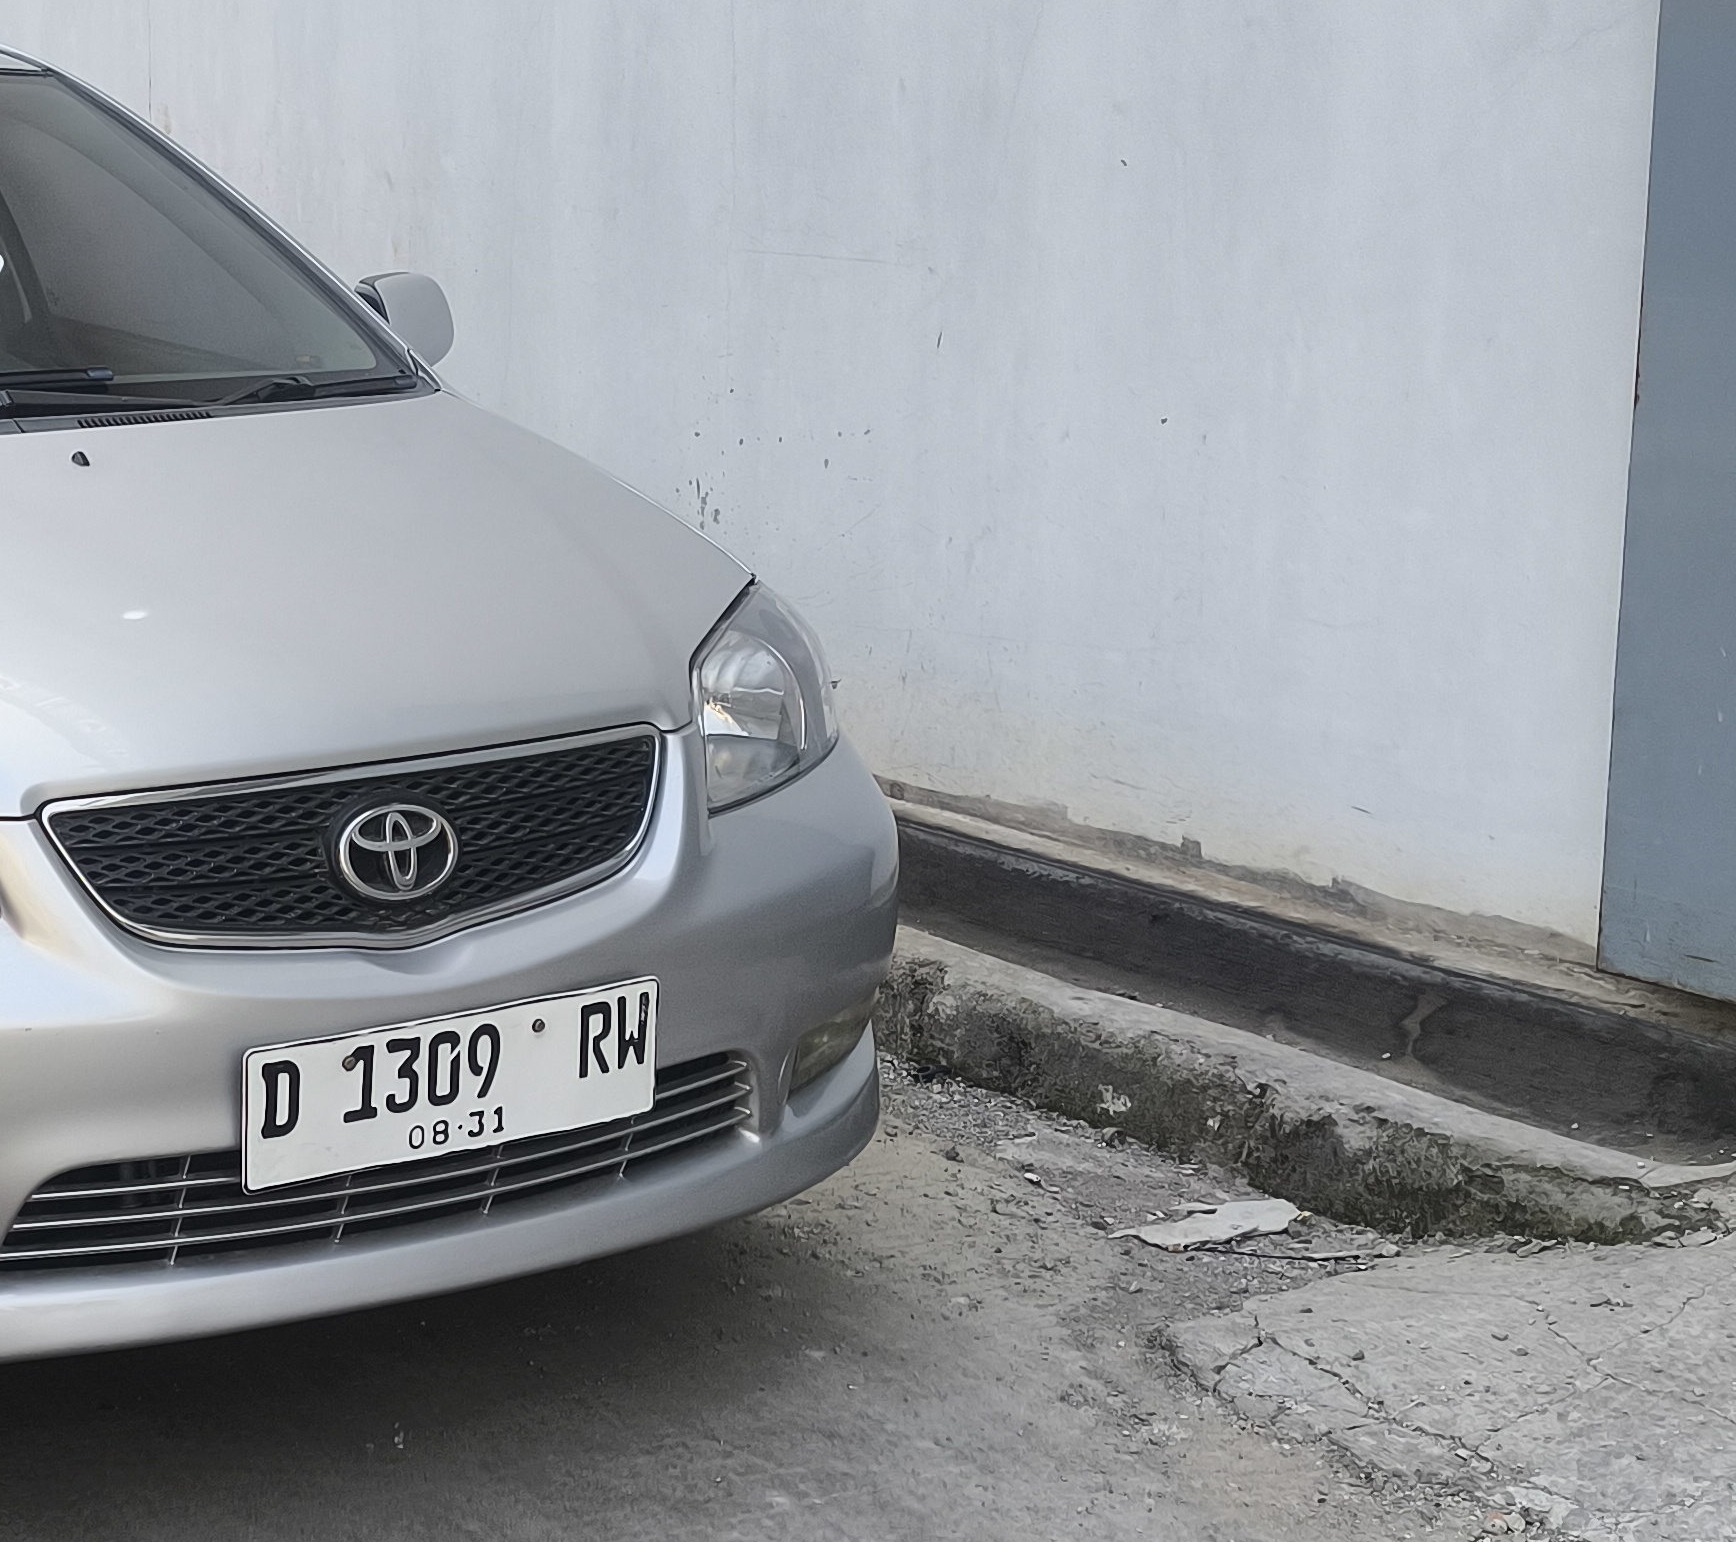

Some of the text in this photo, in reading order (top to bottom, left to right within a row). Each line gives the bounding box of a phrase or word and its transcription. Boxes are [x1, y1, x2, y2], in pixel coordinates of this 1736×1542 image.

[260, 991, 651, 1140] D 1309 RW
